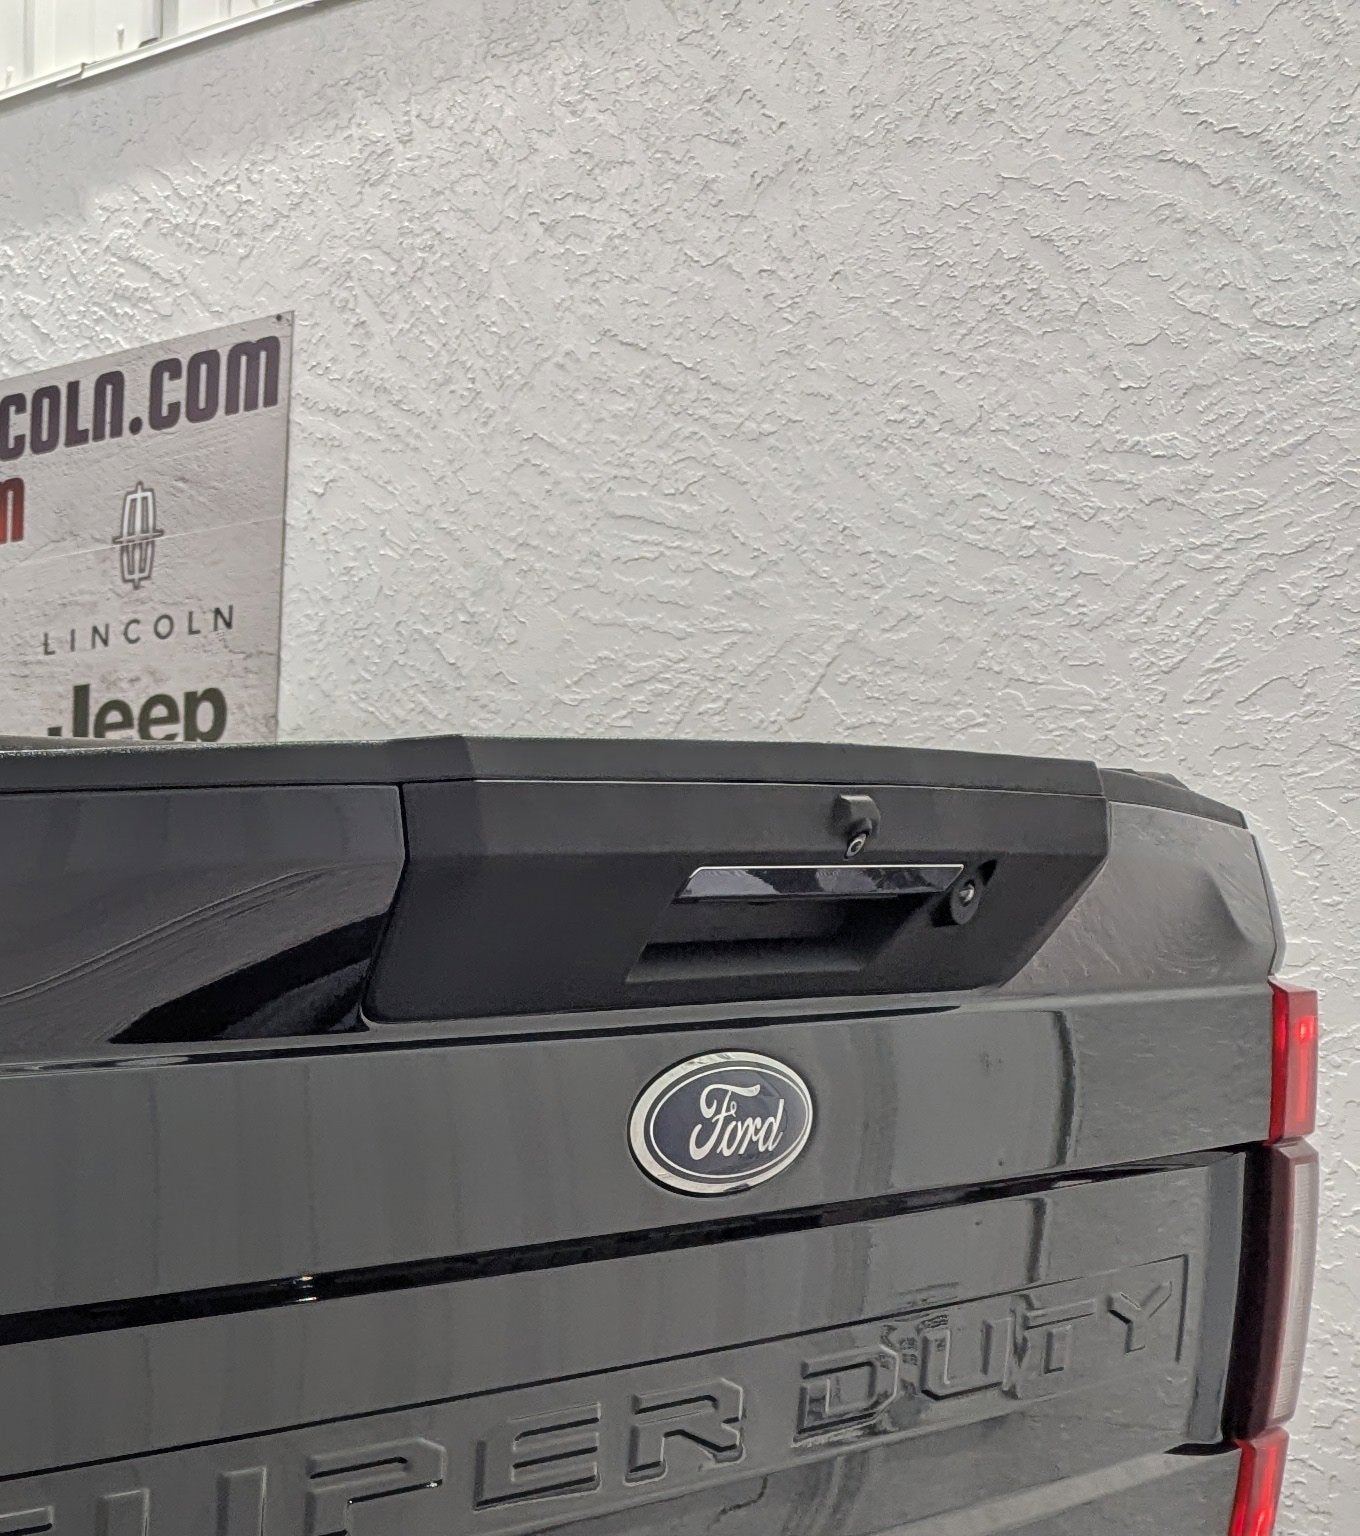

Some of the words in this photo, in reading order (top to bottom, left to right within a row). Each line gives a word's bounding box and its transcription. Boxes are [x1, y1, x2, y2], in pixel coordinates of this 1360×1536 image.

[42, 604, 234, 656] LINCOLN
[47, 683, 228, 743] Jeep
[689, 1083, 785, 1161] Ford
[793, 1279, 1176, 1444] DUTY
